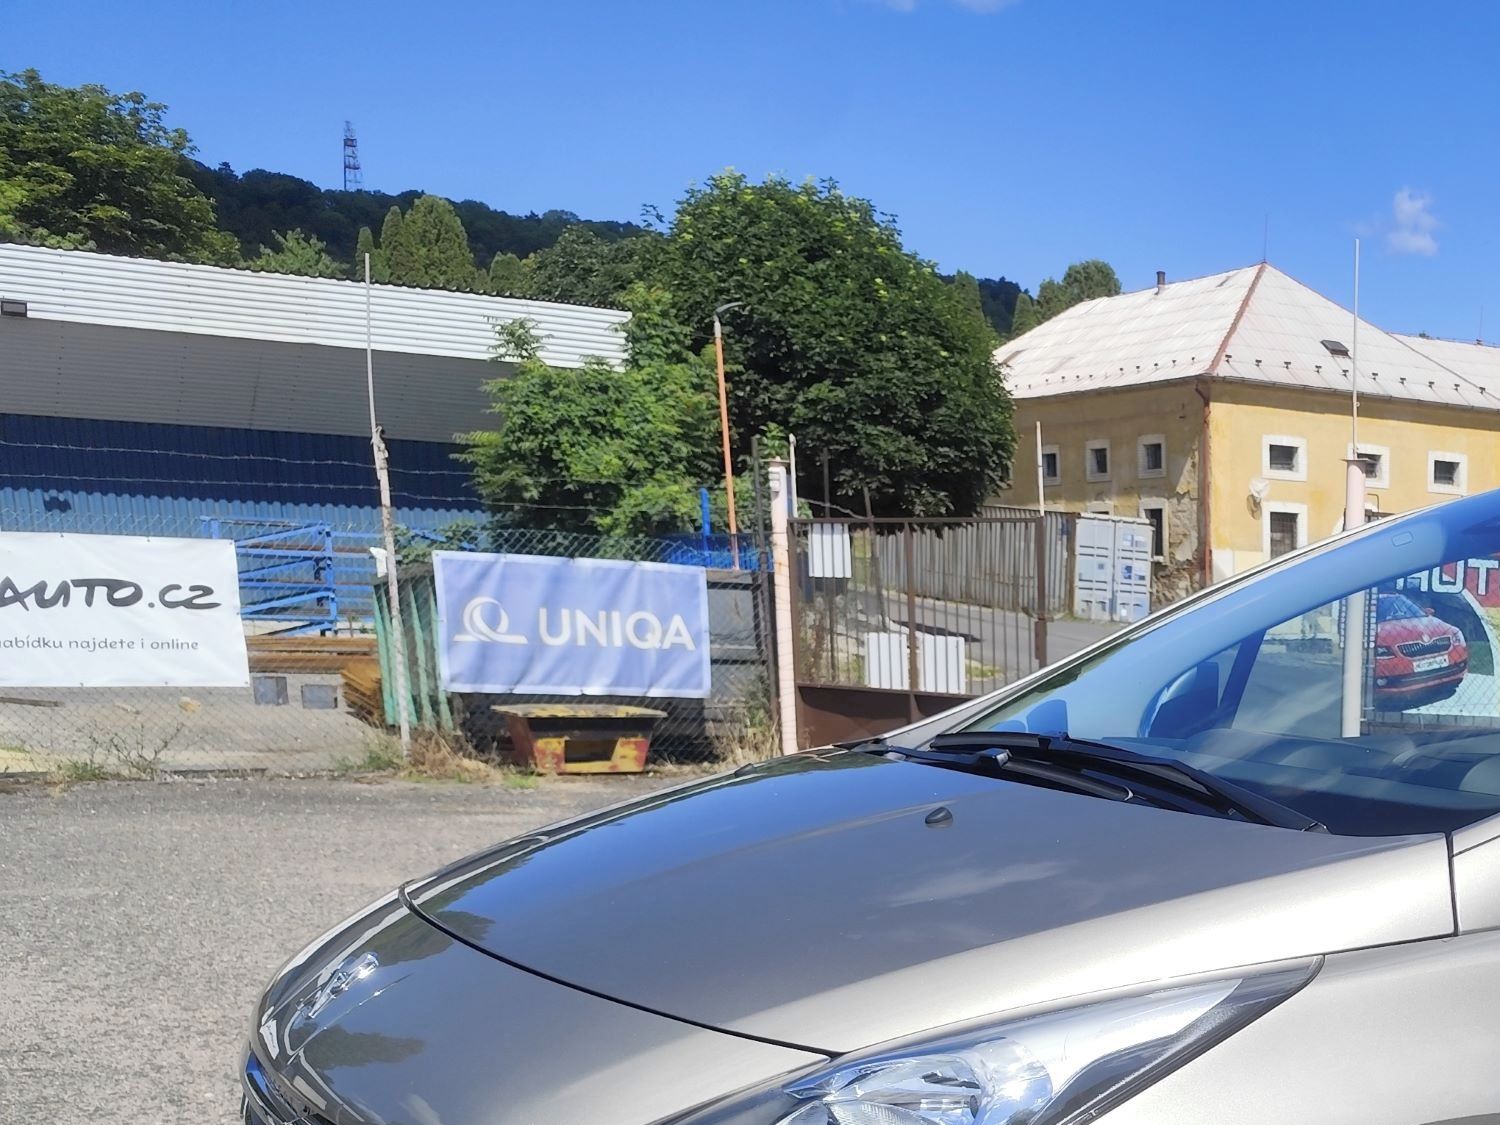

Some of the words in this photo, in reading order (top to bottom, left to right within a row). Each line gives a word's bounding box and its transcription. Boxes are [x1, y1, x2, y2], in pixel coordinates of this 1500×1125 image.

[0, 635, 63, 649] abídku
[68, 637, 136, 652] najdete
[140, 638, 145, 649] i
[150, 638, 199, 650] online
[539, 607, 696, 650] UNIQA
